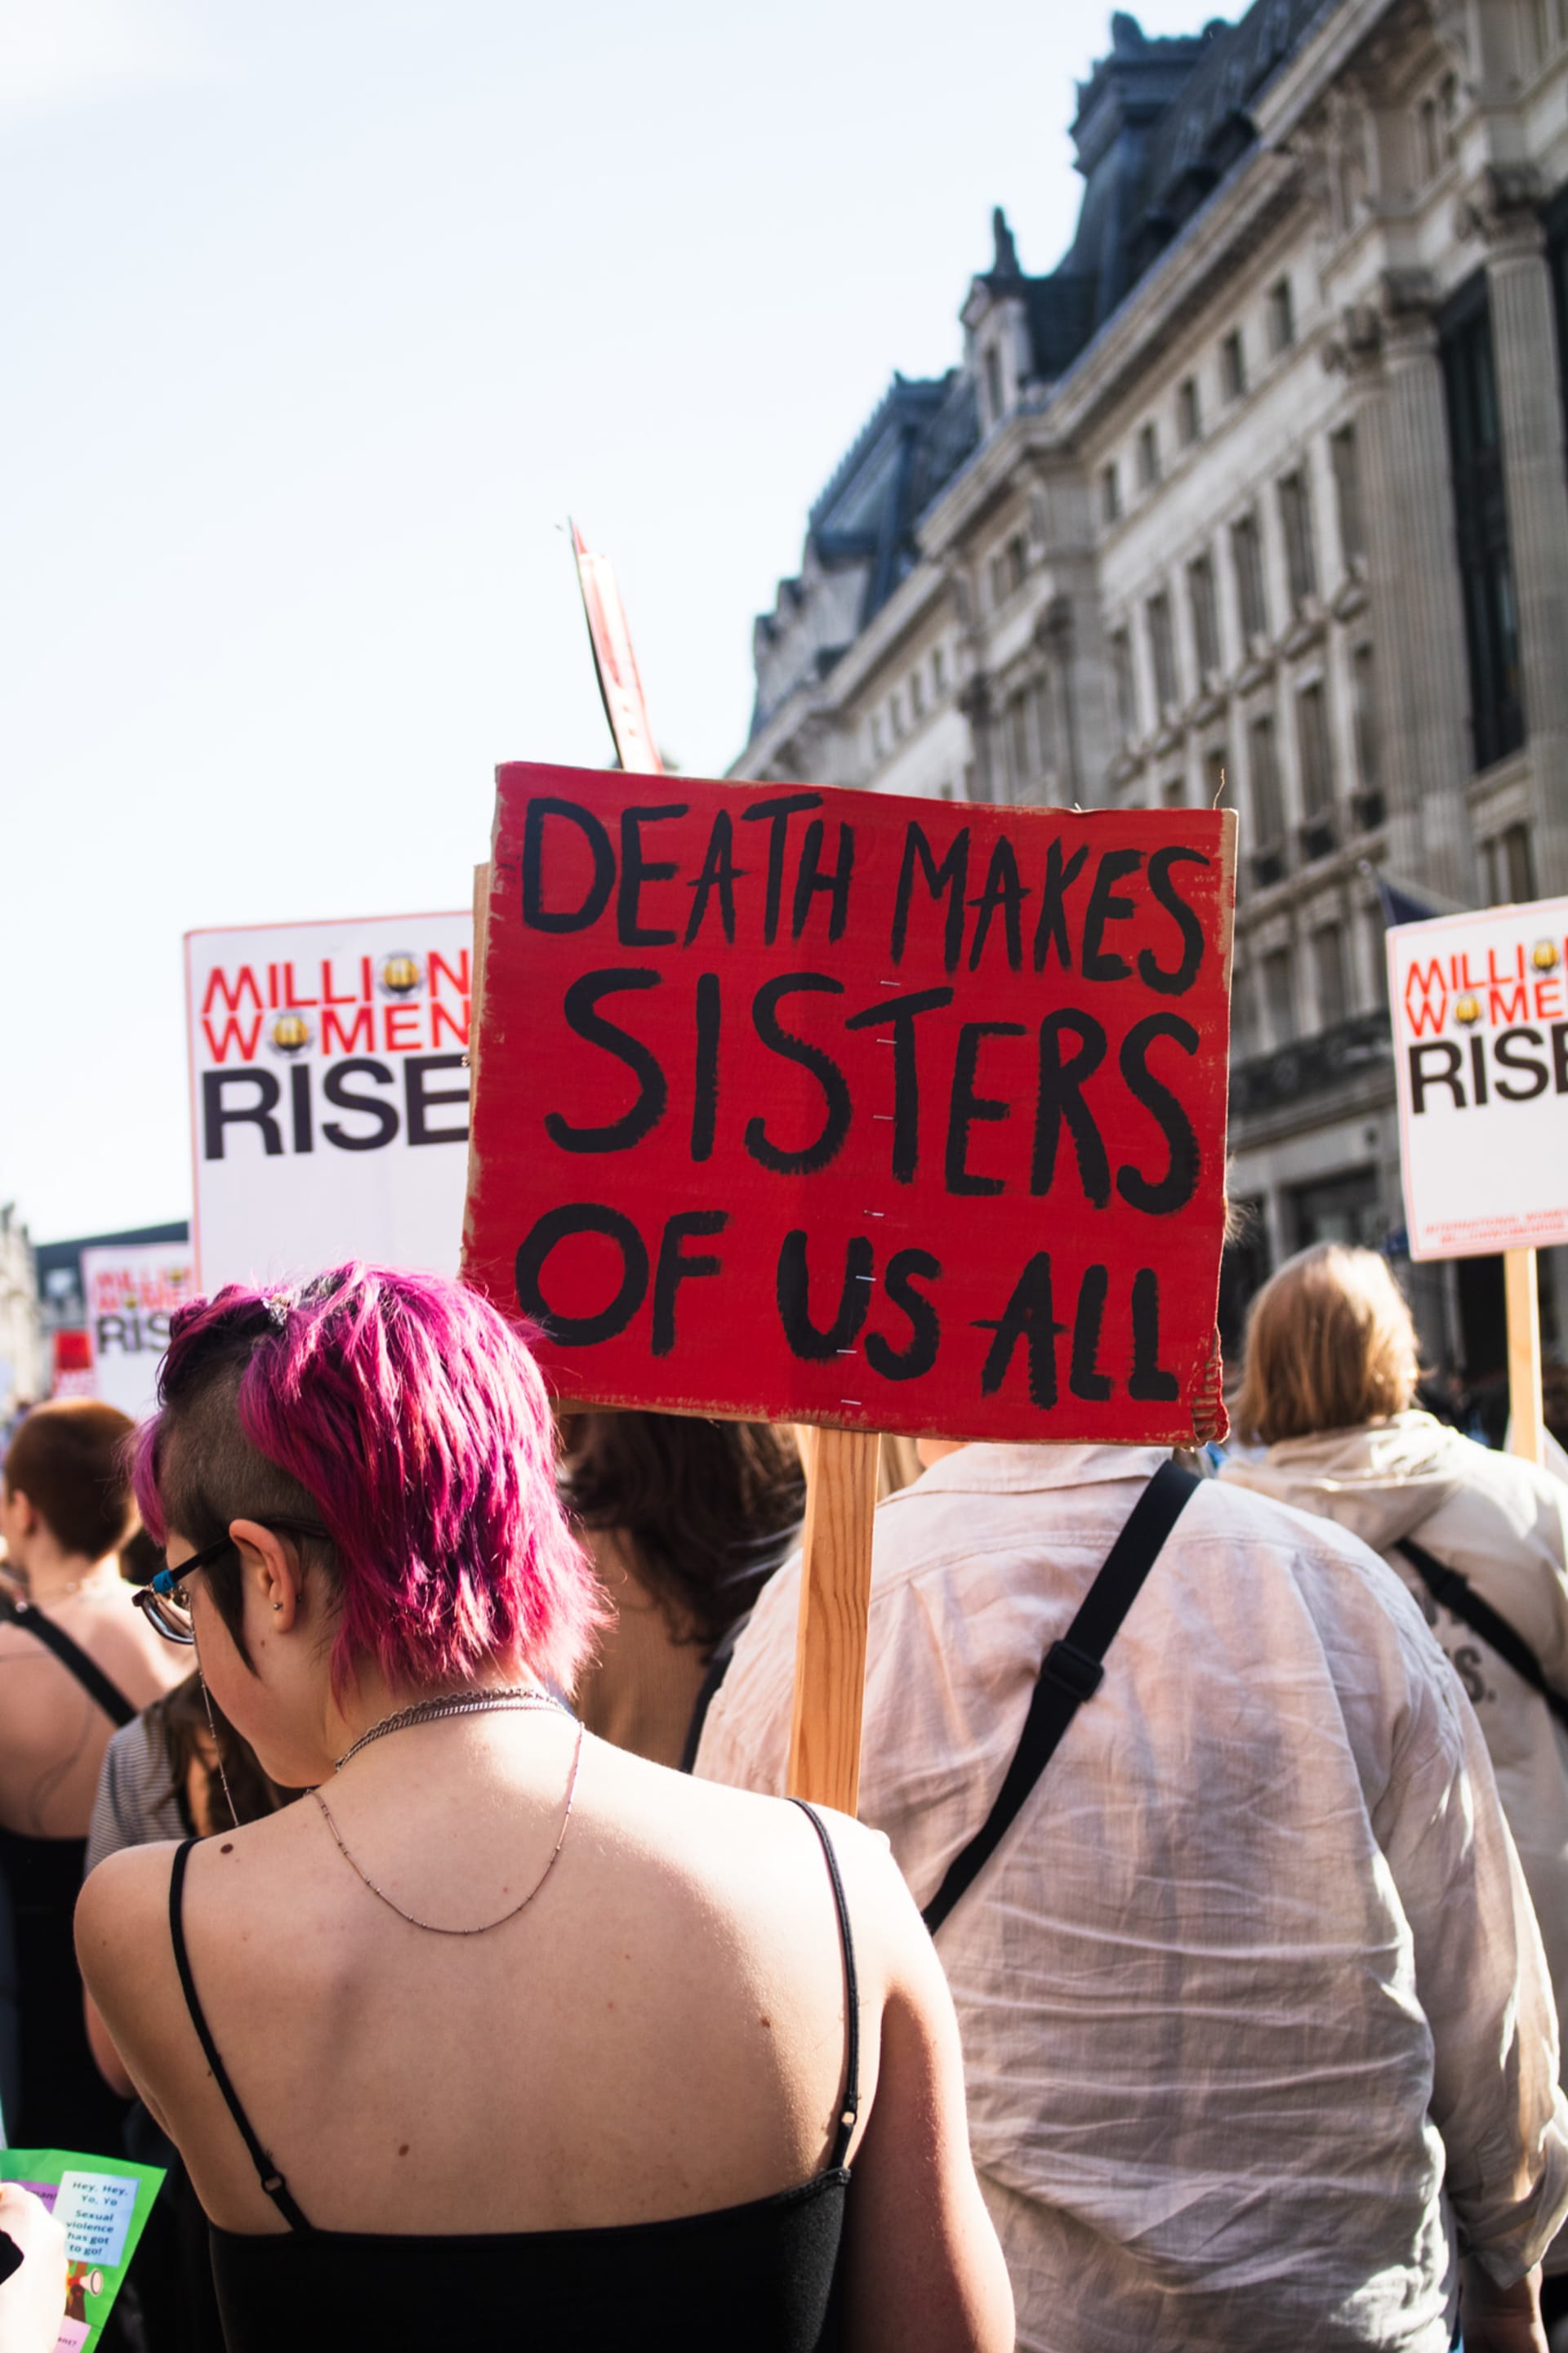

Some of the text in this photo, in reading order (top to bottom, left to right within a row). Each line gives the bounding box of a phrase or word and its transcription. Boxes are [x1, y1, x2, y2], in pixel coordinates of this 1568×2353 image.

[521, 791, 1211, 996] DEATH MAKES
[202, 1053, 470, 1160] RISE
[543, 966, 1201, 1216] SISTERS
[514, 1202, 1180, 1411] OF US ALL
[66, 2221, 114, 2234] violence
[67, 2231, 109, 2246] has got
[75, 2209, 114, 2222] Sexual
[69, 2244, 82, 2253] to
